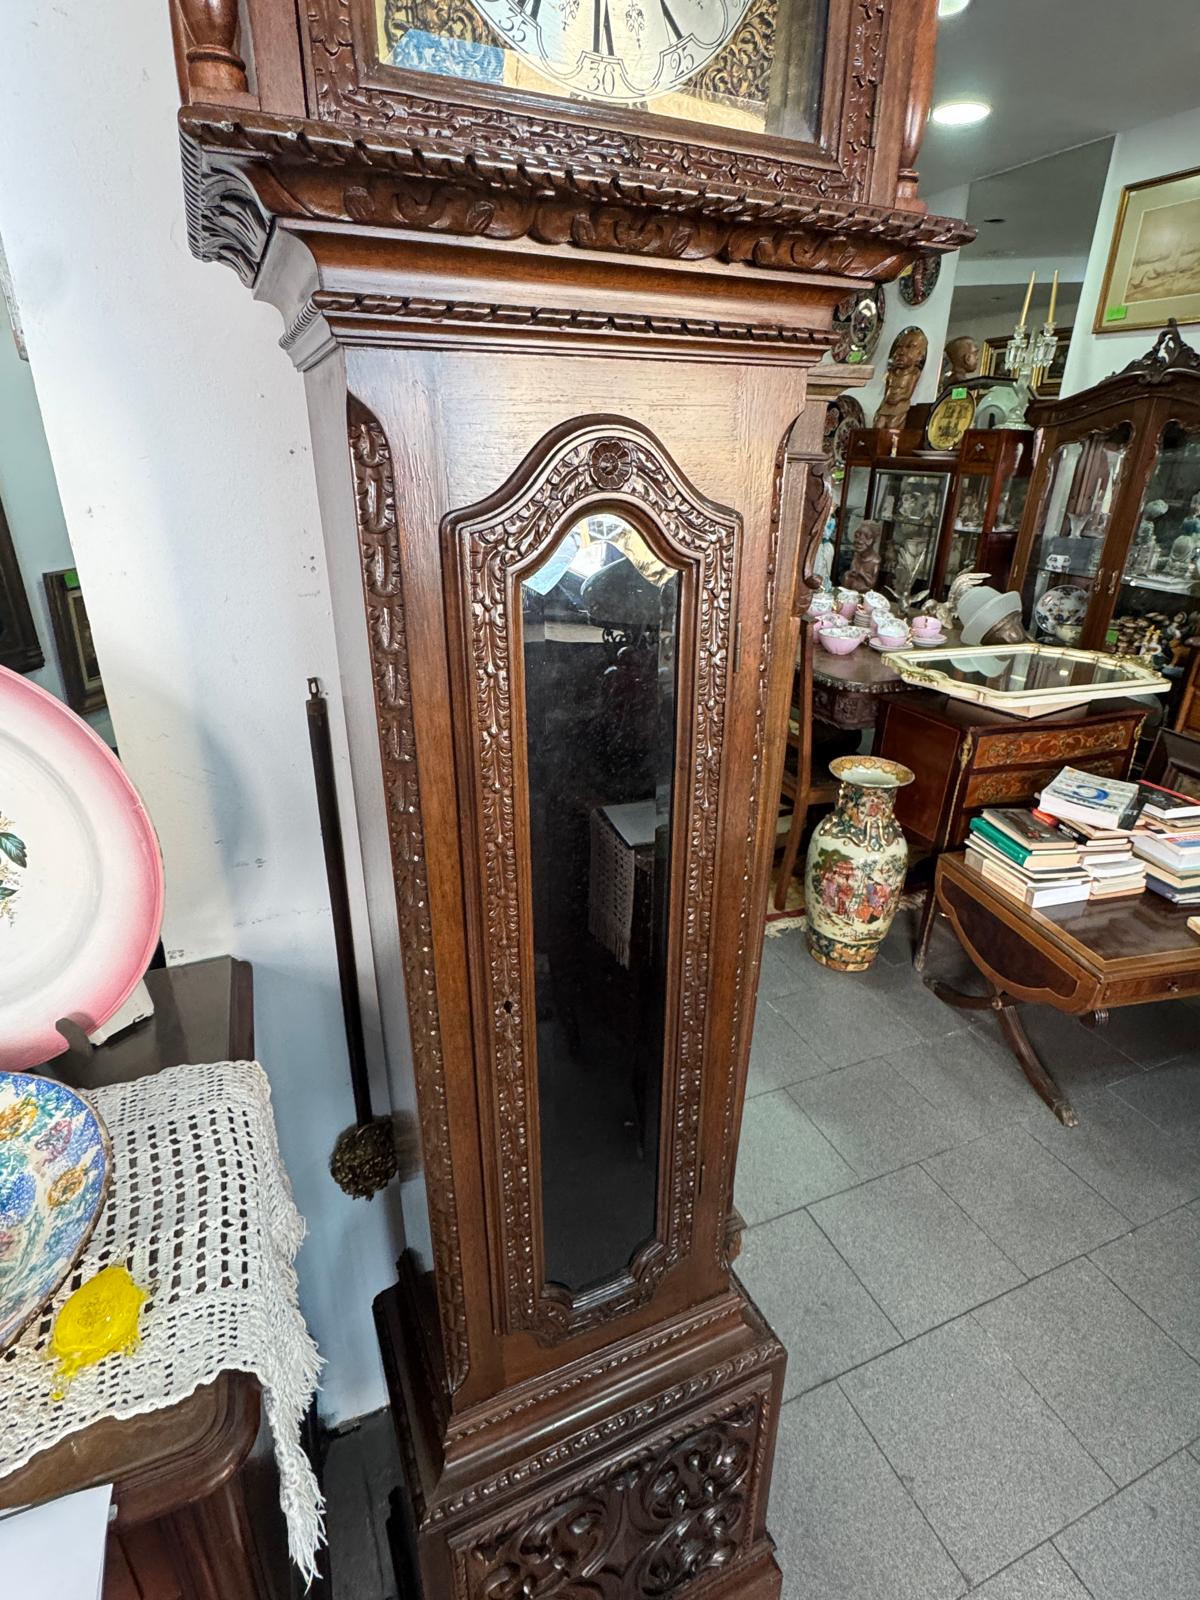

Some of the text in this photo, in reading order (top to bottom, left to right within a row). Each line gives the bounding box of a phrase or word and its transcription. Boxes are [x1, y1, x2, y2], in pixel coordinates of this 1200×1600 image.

[498, 7, 527, 42] 35
[586, 61, 616, 96] 30
[669, 45, 695, 79] 25
